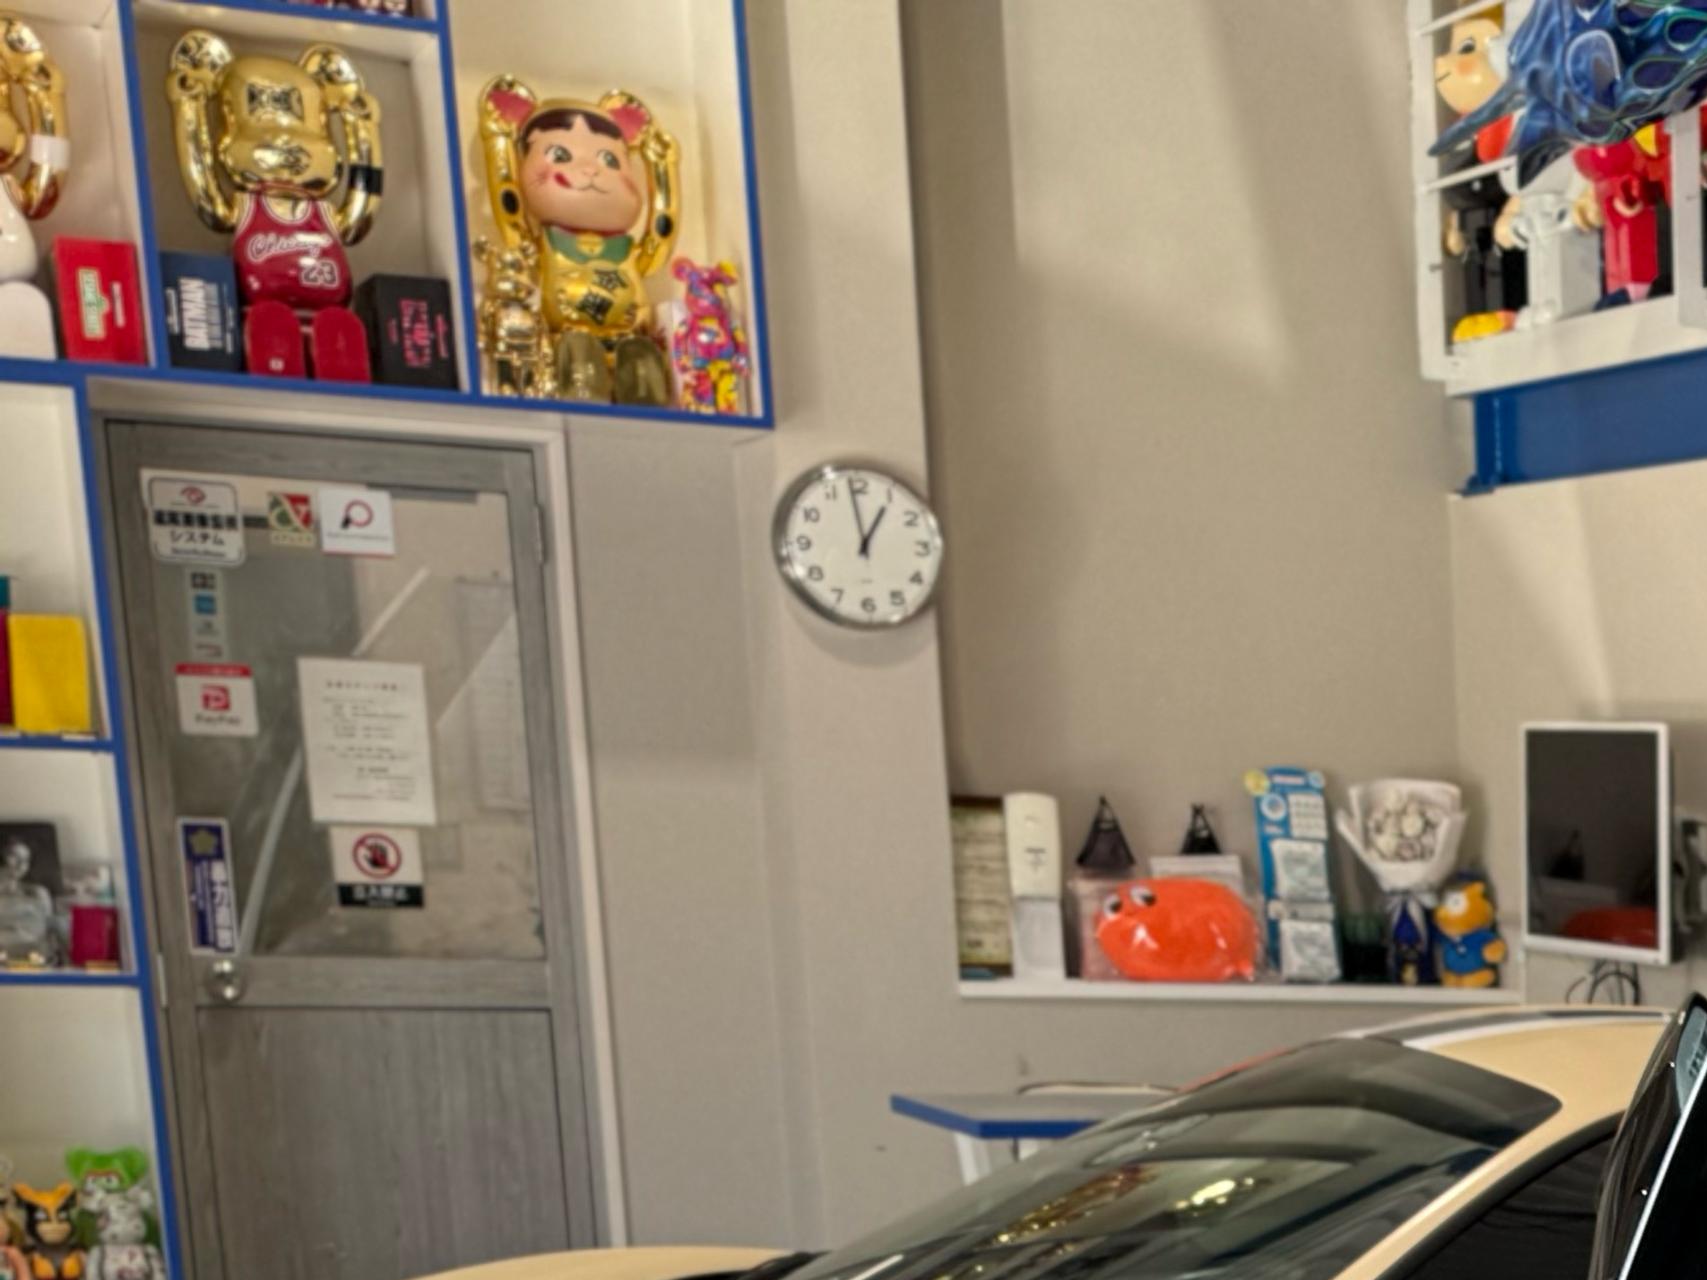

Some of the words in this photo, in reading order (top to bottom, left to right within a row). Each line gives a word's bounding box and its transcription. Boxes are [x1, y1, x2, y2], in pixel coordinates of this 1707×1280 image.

[804, 507, 820, 523] 10
[903, 510, 918, 528] 2
[796, 536, 812, 551] 9
[915, 540, 931, 557] 3
[808, 565, 824, 581] 8
[909, 570, 923, 585] 4
[831, 588, 844, 603] 7
[890, 590, 905, 607] 5
[861, 597, 877, 613] 6
